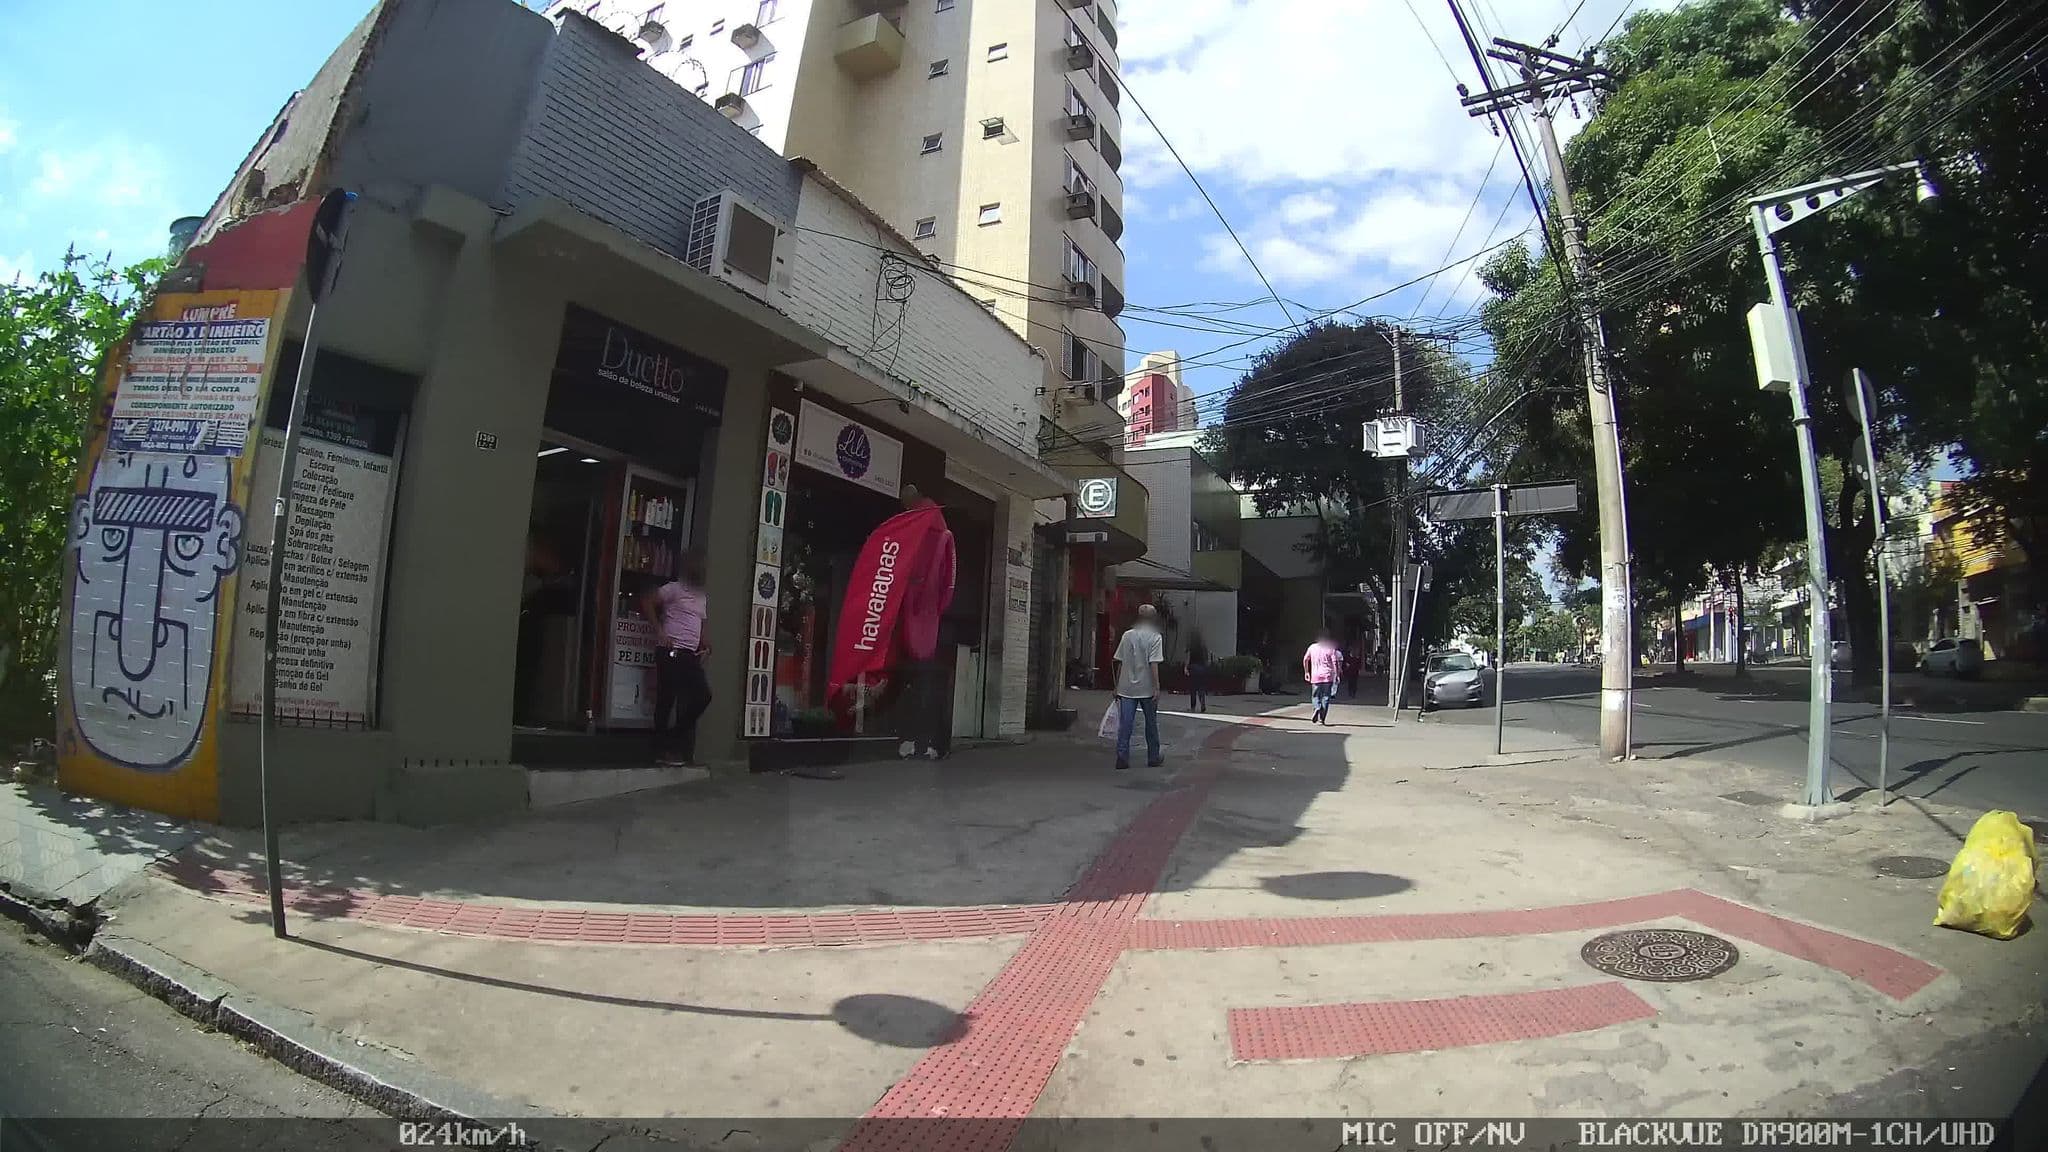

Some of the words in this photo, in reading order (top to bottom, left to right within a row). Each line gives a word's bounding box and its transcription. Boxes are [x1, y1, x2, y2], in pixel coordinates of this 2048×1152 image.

[186, 326, 198, 338] X
[601, 328, 684, 393] Duetto
[619, 376, 629, 385] de
[309, 459, 335, 473] Escova
[302, 468, 338, 486] Coloração
[294, 480, 316, 492] nicure
[322, 485, 354, 501] Pedicure
[1088, 484, 1105, 507] E
[295, 503, 335, 519] Massagem
[319, 496, 329, 507] de
[330, 498, 346, 510] Pele
[296, 515, 331, 531] Depilação
[305, 529, 319, 540] dos
[287, 537, 334, 554] Sobrancelha
[284, 562, 296, 571] em
[336, 571, 368, 583] extensão
[284, 572, 329, 589] Manutenção
[281, 595, 327, 612] Manutenção
[290, 587, 301, 596] em
[303, 588, 315, 599] gel
[325, 592, 358, 605] extensão
[854, 540, 899, 651] havaianas
[280, 619, 325, 636] Manutenção
[285, 610, 296, 619] em
[326, 615, 359, 628] extensão
[307, 648, 326, 658] unha
[301, 658, 335, 670] definitiva
[305, 671, 315, 680] de
[316, 671, 329, 681] Gel
[299, 682, 308, 691] de
[310, 682, 323, 692] Gel
